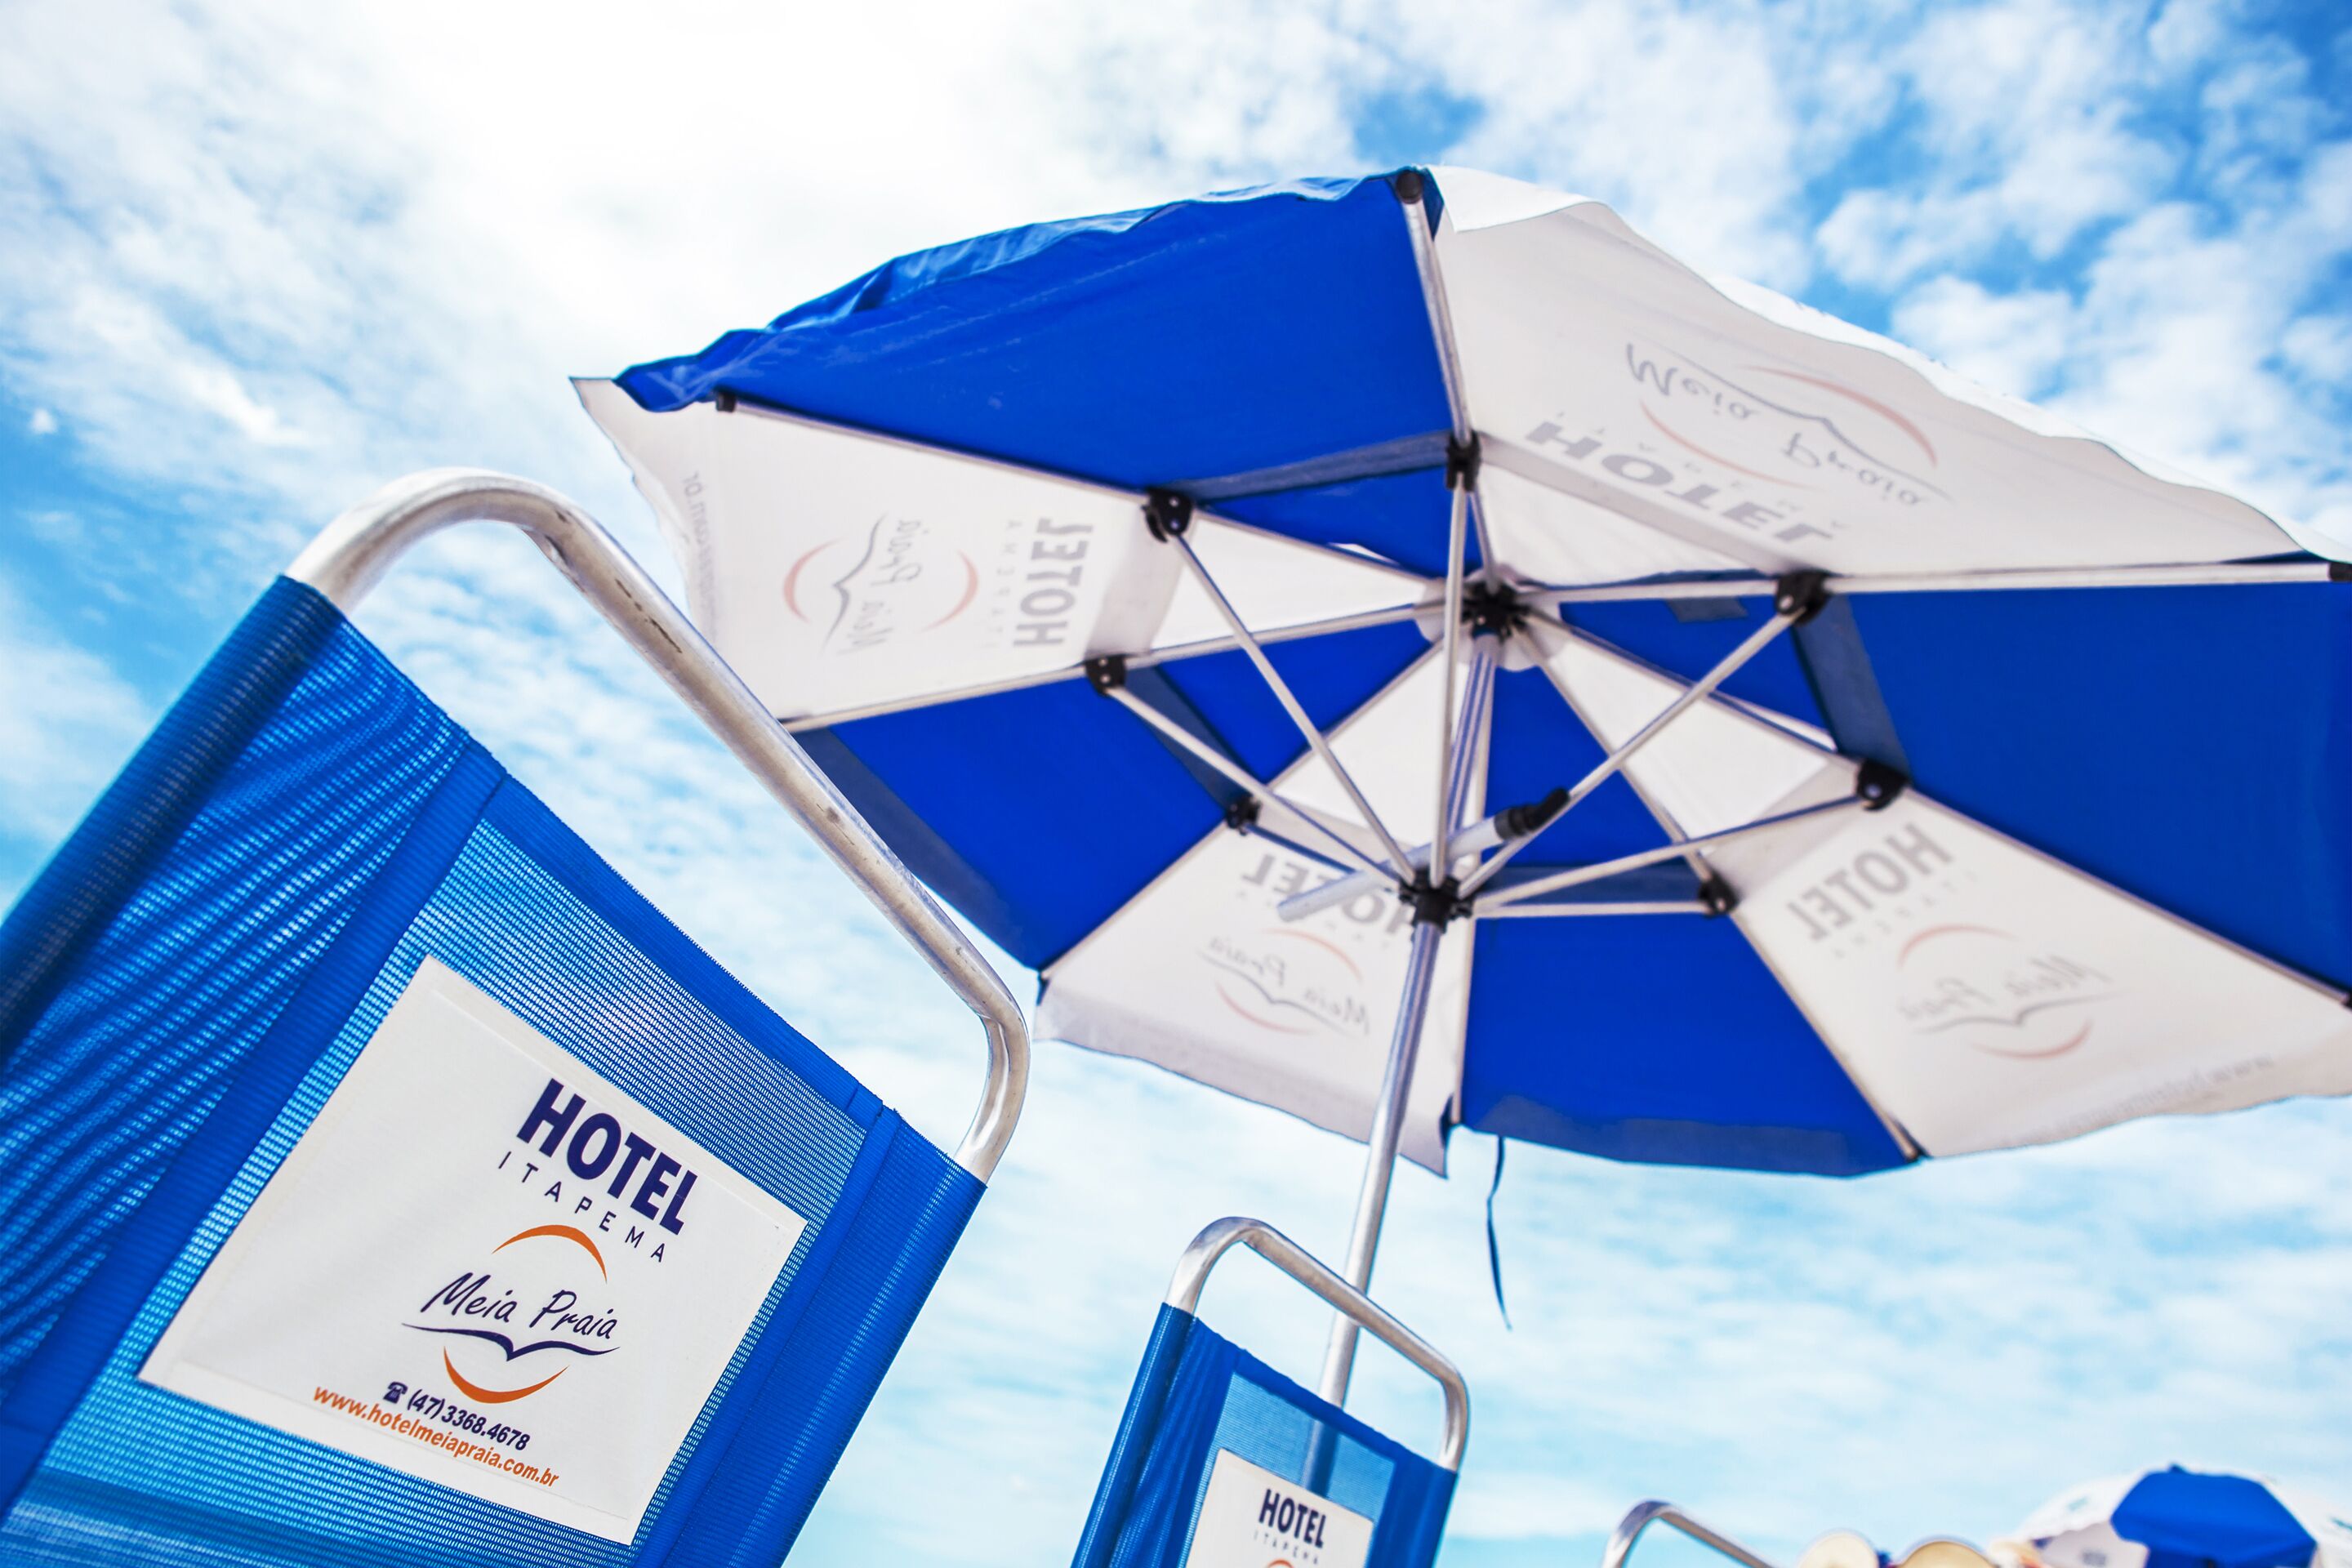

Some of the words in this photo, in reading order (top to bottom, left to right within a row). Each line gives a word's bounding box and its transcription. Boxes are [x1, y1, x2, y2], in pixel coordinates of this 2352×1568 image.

[497, 1151, 666, 1263] ITAPEMA
[516, 1078, 697, 1236] HOTEL
[420, 1272, 518, 1324] Meia
[529, 1289, 620, 1339] Praia
[313, 1386, 560, 1488] www.hotelmeiapraia.com.br
[1258, 1488, 1327, 1549] HOTEL
